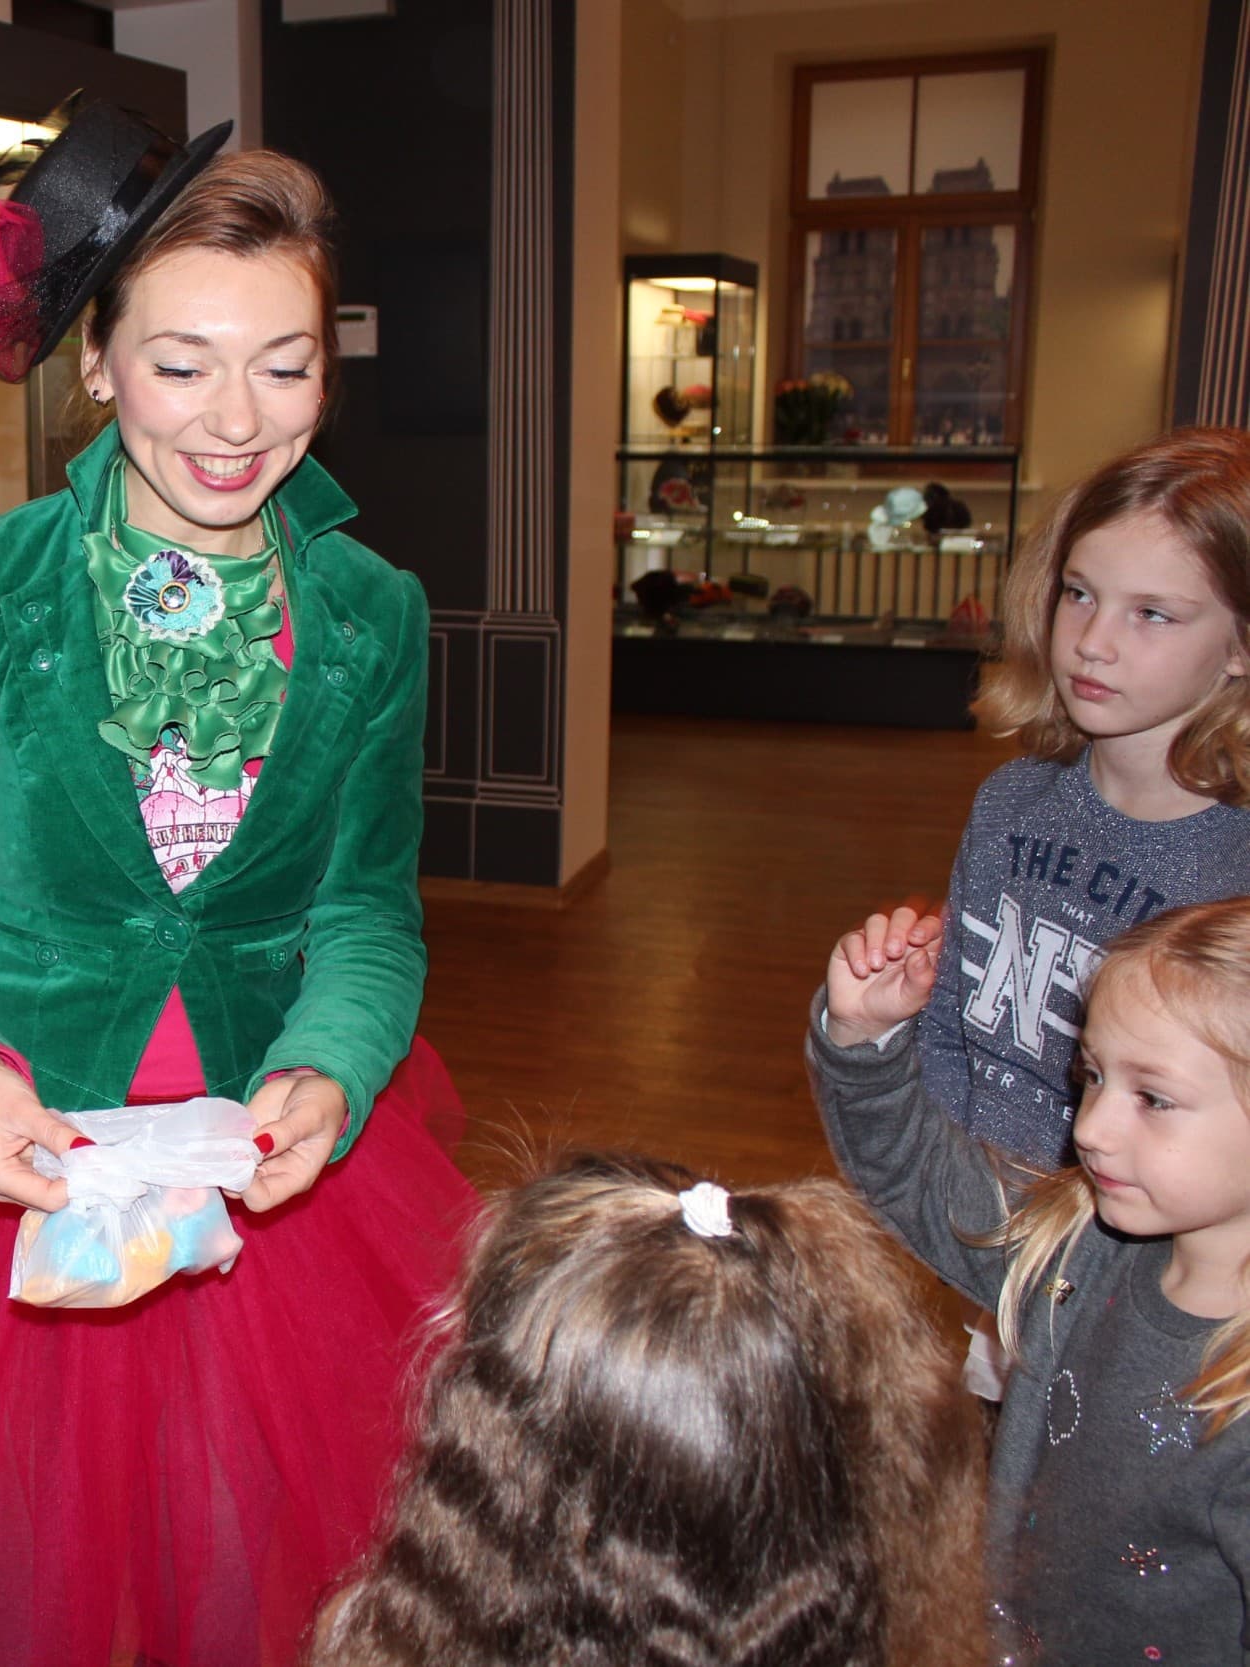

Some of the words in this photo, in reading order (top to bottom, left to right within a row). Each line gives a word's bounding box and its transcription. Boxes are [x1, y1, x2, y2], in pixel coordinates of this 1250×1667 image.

[1007, 833, 1081, 887] THE
[1060, 901, 1095, 926] THAT
[1087, 861, 1168, 924] CIT
